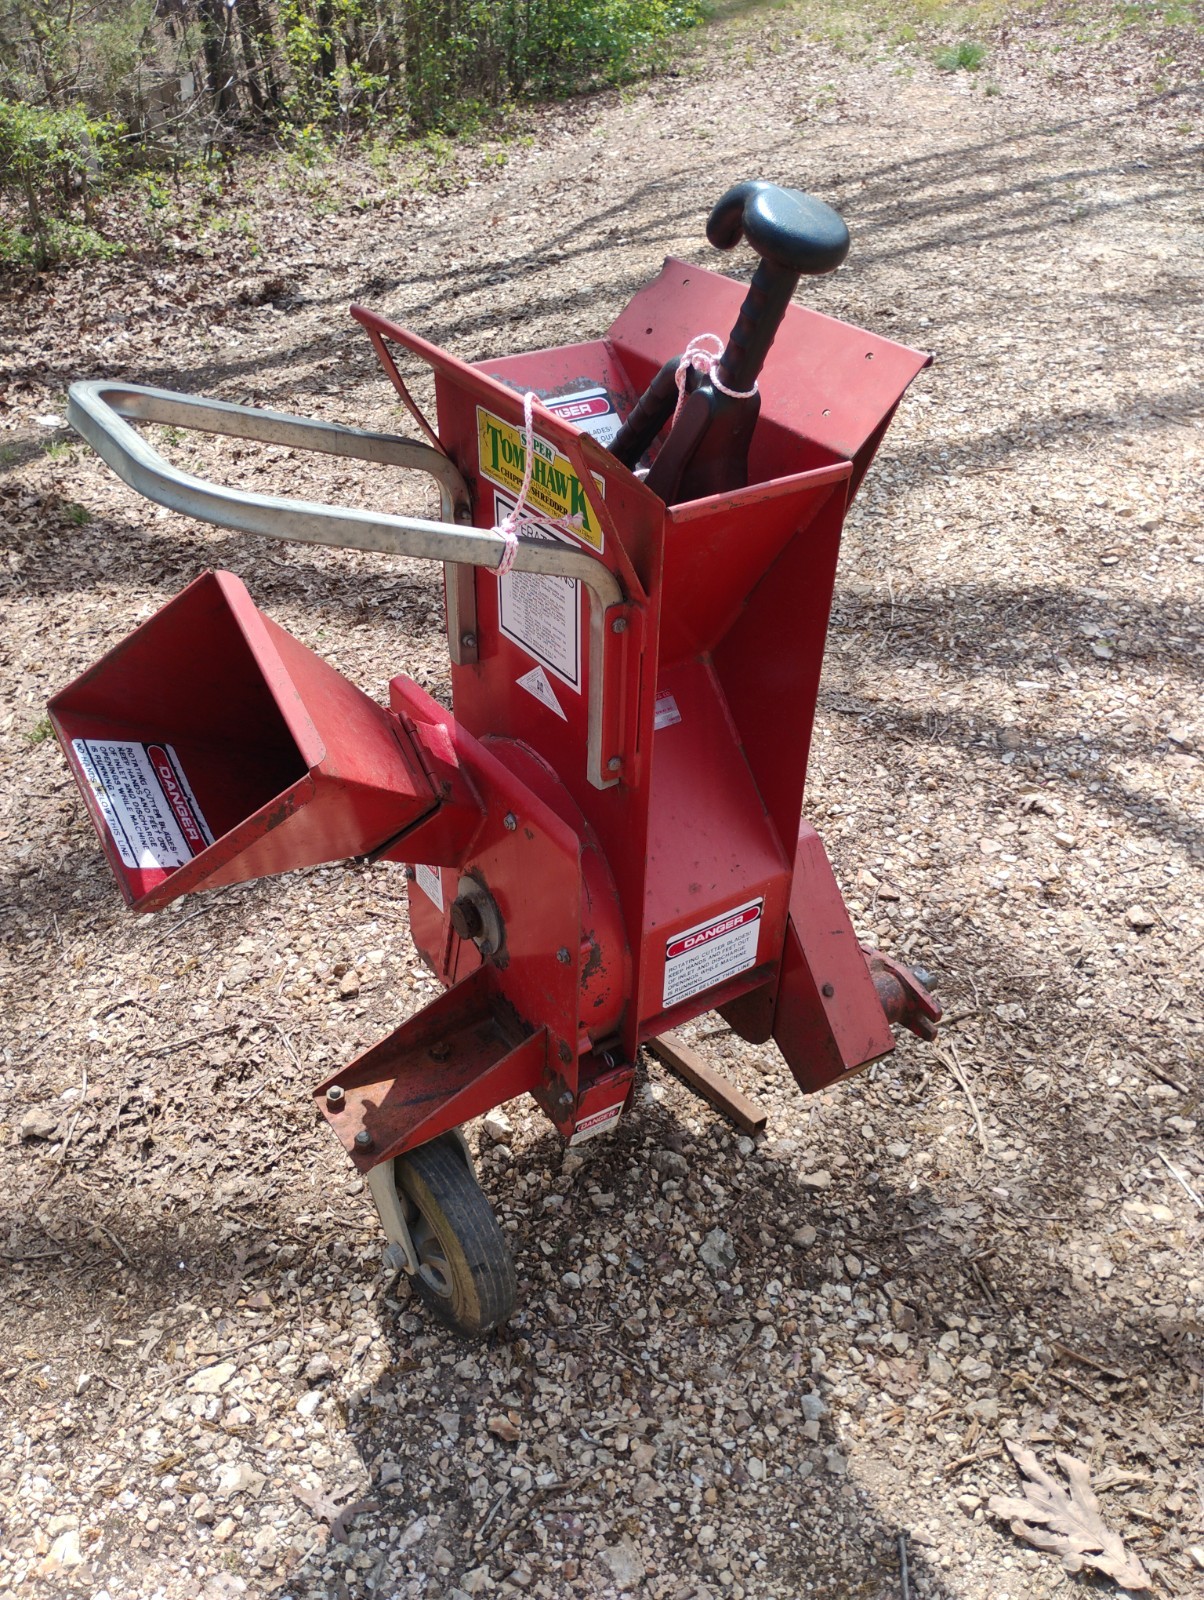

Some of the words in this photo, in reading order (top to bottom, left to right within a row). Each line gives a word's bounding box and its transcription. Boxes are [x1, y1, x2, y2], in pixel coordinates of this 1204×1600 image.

[521, 433, 552, 461] SPER
[600, 434, 614, 442] OUT
[486, 421, 592, 532] TOMHAWK
[74, 742, 84, 753] NO
[80, 756, 97, 782] HANDS
[108, 819, 121, 836] THIS
[117, 840, 130, 858] LINE
[98, 746, 121, 785] OPENINGS
[117, 788, 133, 811] WHILE
[128, 814, 149, 850] MACHINE
[107, 747, 117, 755] OF
[113, 759, 128, 780] INLET
[123, 783, 135, 798] AND
[131, 801, 157, 847] DISCHARGE
[115, 747, 130, 765] KEEP
[125, 768, 143, 794] HANDS
[137, 796, 150, 813] AND
[146, 815, 160, 835] FEET
[156, 836, 169, 853] OUT
[124, 747, 147, 785] ROTATING
[142, 788, 162, 818] CUTTER
[157, 766, 199, 841] DANGER
[684, 914, 743, 948] DANGER
[667, 972, 698, 990] OPENINGS
[700, 962, 718, 975] WHILE
[720, 949, 746, 965] MACHINE
[668, 967, 683, 978] KEEP
[685, 957, 705, 970] HANDS
[708, 950, 720, 959] AND
[722, 943, 735, 953] FEET
[737, 936, 749, 946] OUT
[668, 954, 699, 973] ROTATING
[701, 943, 724, 957] CUTTER
[678, 968, 694, 979] INLET
[697, 961, 709, 970] AND
[711, 944, 745, 964] DISCHARGE
[665, 998, 673, 1006] NO
[676, 987, 696, 1001] HANDS
[699, 977, 718, 990] BELOW
[722, 968, 735, 978] THIS
[737, 962, 749, 971] LINE
[675, 976, 702, 992] RUNNING
[580, 1109, 616, 1130] DANGER
